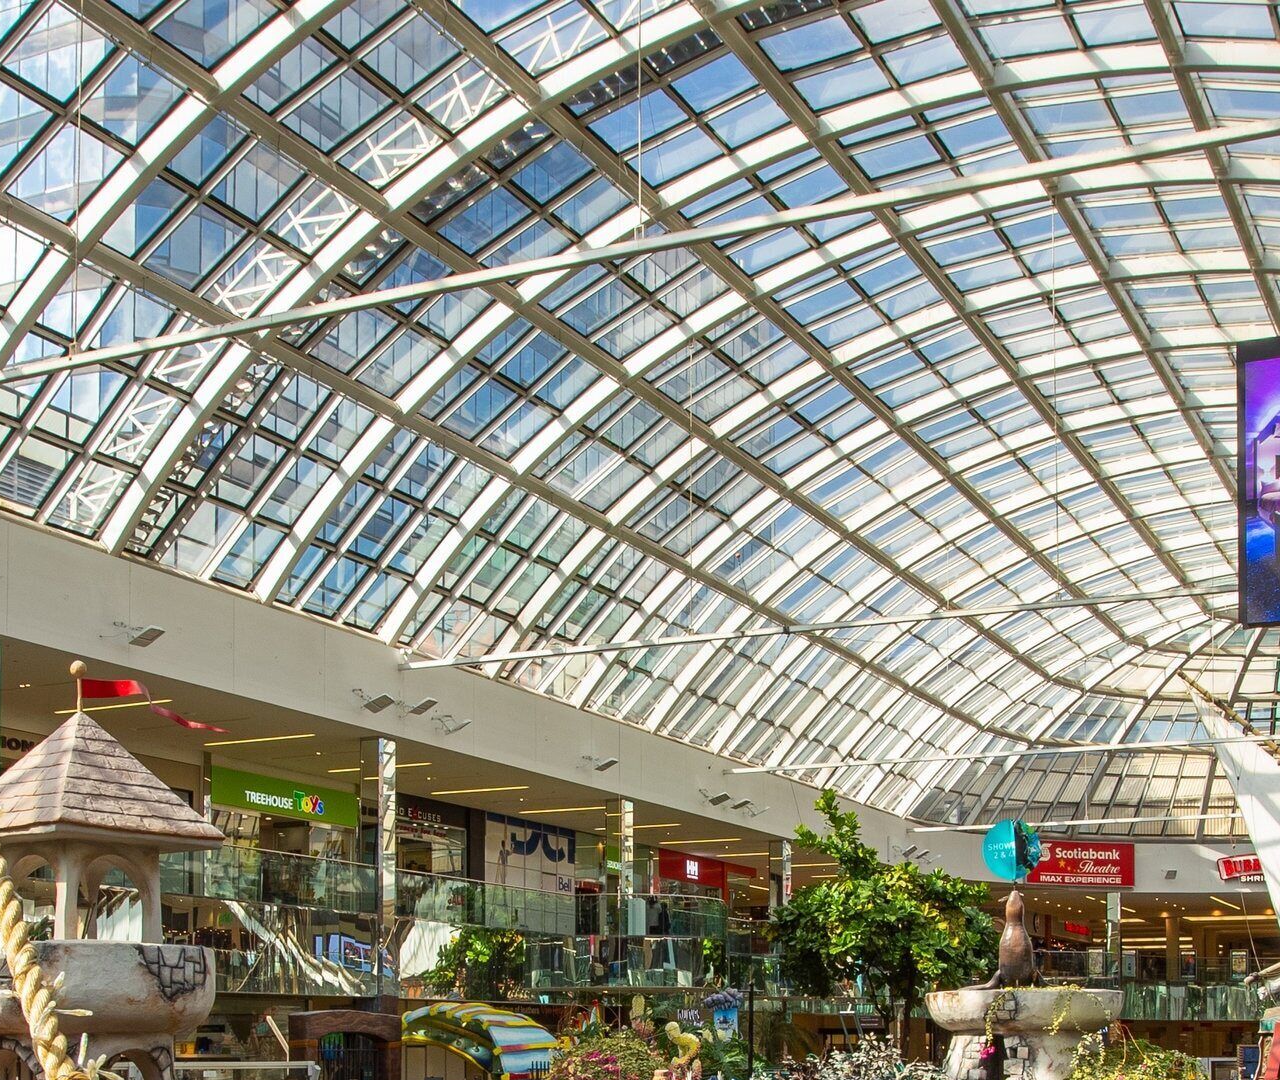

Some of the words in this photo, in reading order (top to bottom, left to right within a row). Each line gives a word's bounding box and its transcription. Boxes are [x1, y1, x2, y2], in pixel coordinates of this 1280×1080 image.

[244, 789, 294, 810] TREEHOUSE
[1055, 846, 1120, 861] Scotiabank
[1077, 861, 1121, 875] Theatre
[558, 876, 572, 892] Bell
[1039, 874, 1064, 883] IMAX
[1064, 875, 1122, 885] EXPERIENCE
